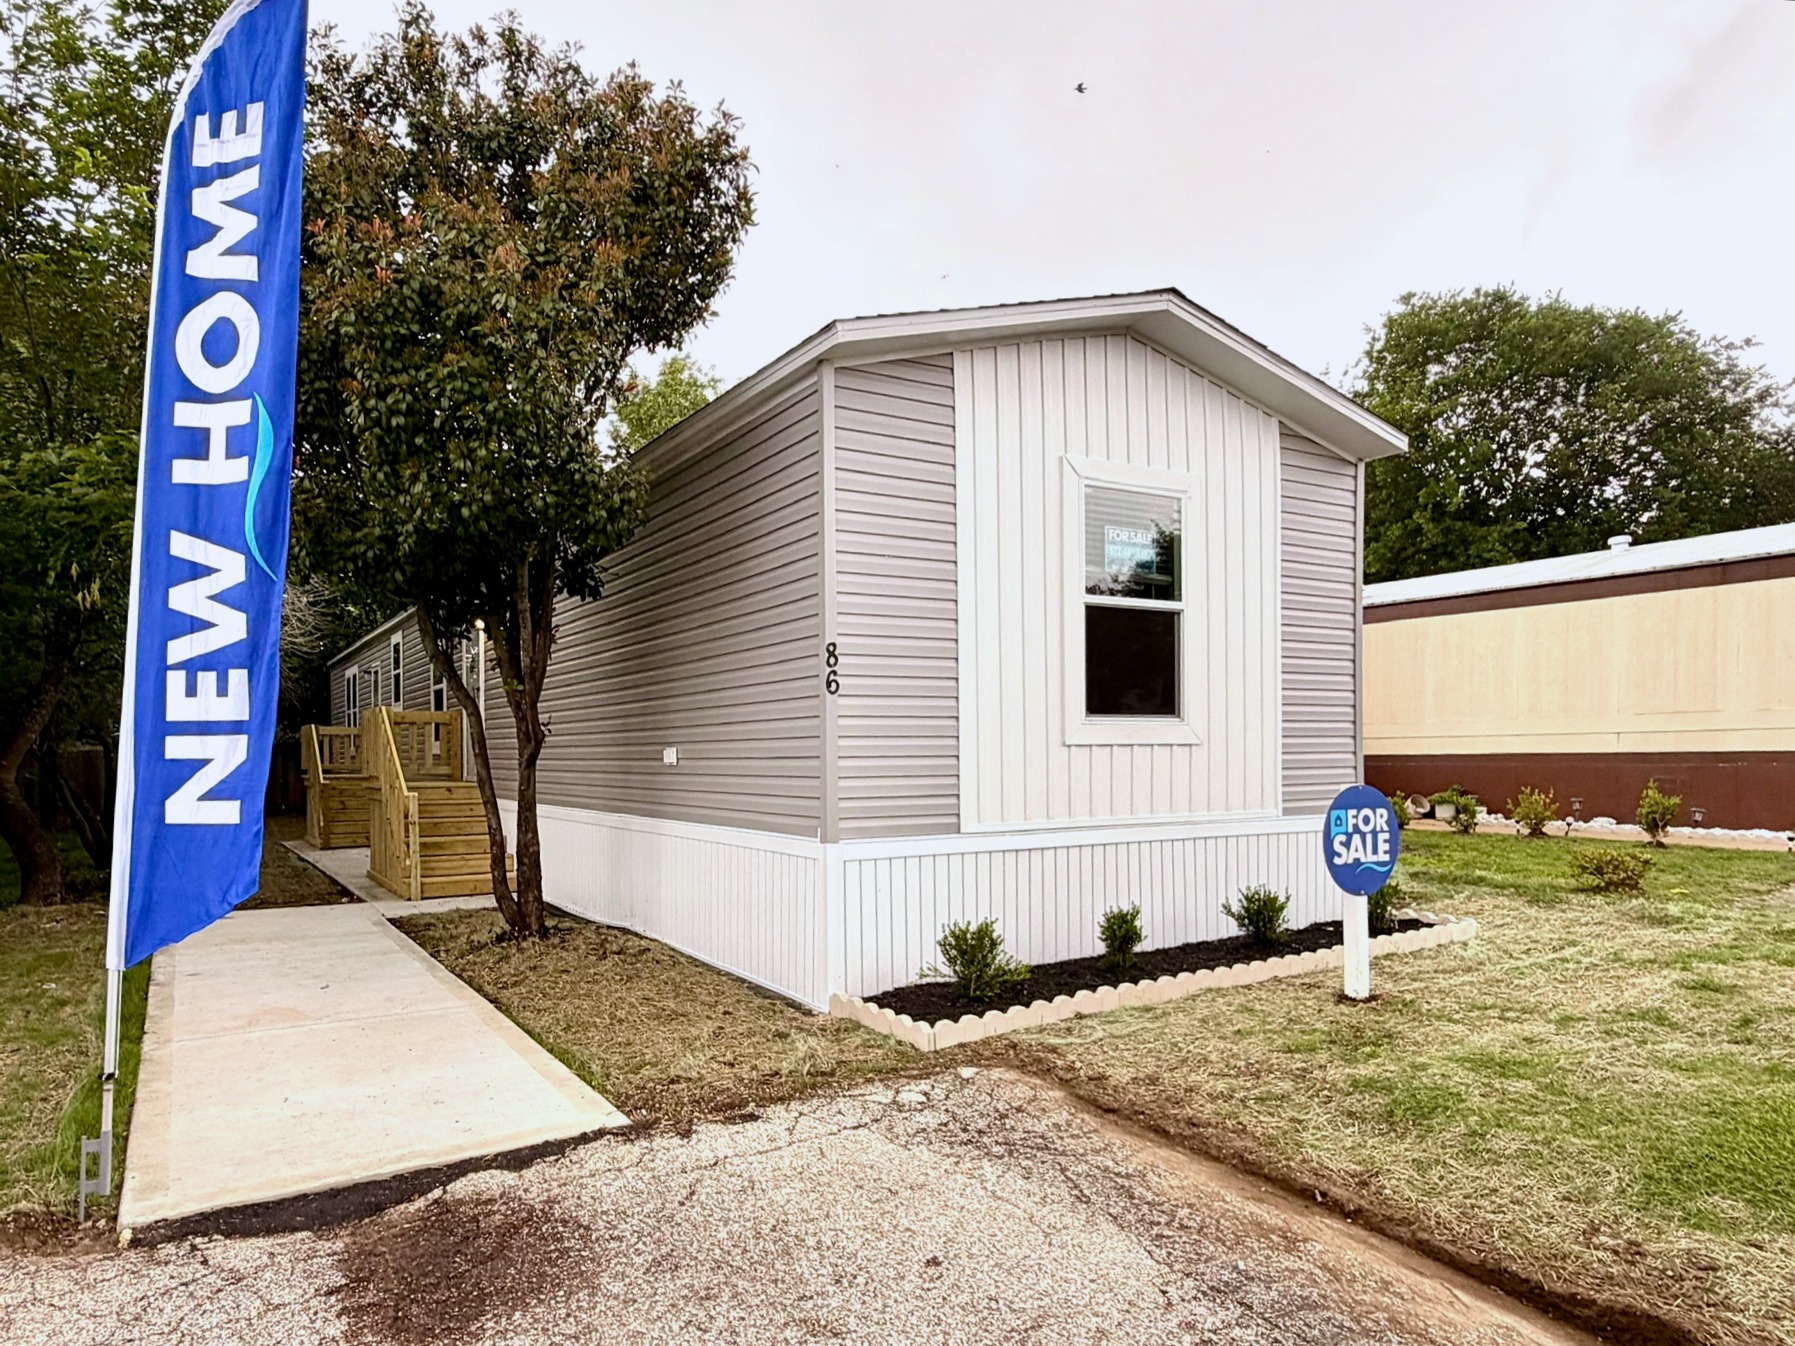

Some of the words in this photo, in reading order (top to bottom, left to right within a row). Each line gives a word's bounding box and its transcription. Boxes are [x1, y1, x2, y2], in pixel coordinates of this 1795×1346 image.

[171, 101, 264, 485] HOME
[1108, 529, 1130, 543] FOR
[1130, 531, 1153, 545] SALE
[165, 530, 250, 825] NEW
[1347, 808, 1389, 833] FOR
[1333, 833, 1390, 865] SALE
